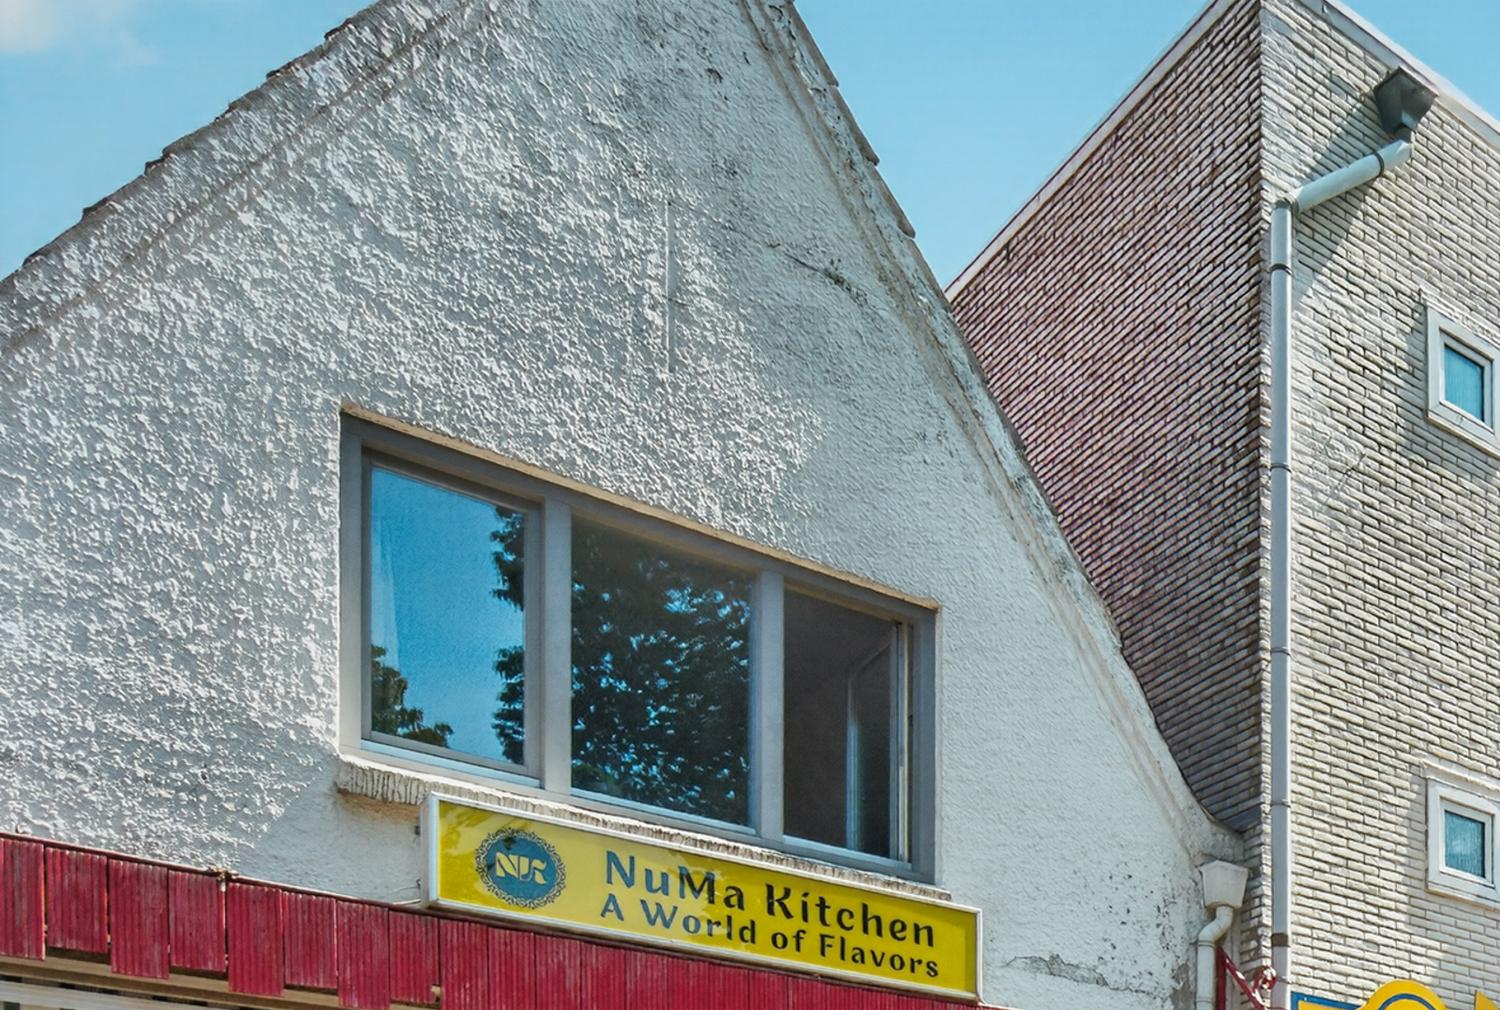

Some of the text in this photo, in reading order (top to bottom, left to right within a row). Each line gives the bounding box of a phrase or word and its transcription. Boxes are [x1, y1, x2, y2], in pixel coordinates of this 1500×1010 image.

[600, 893, 939, 978] A World of Flavors
[605, 850, 934, 948] NuMa Kitchen
